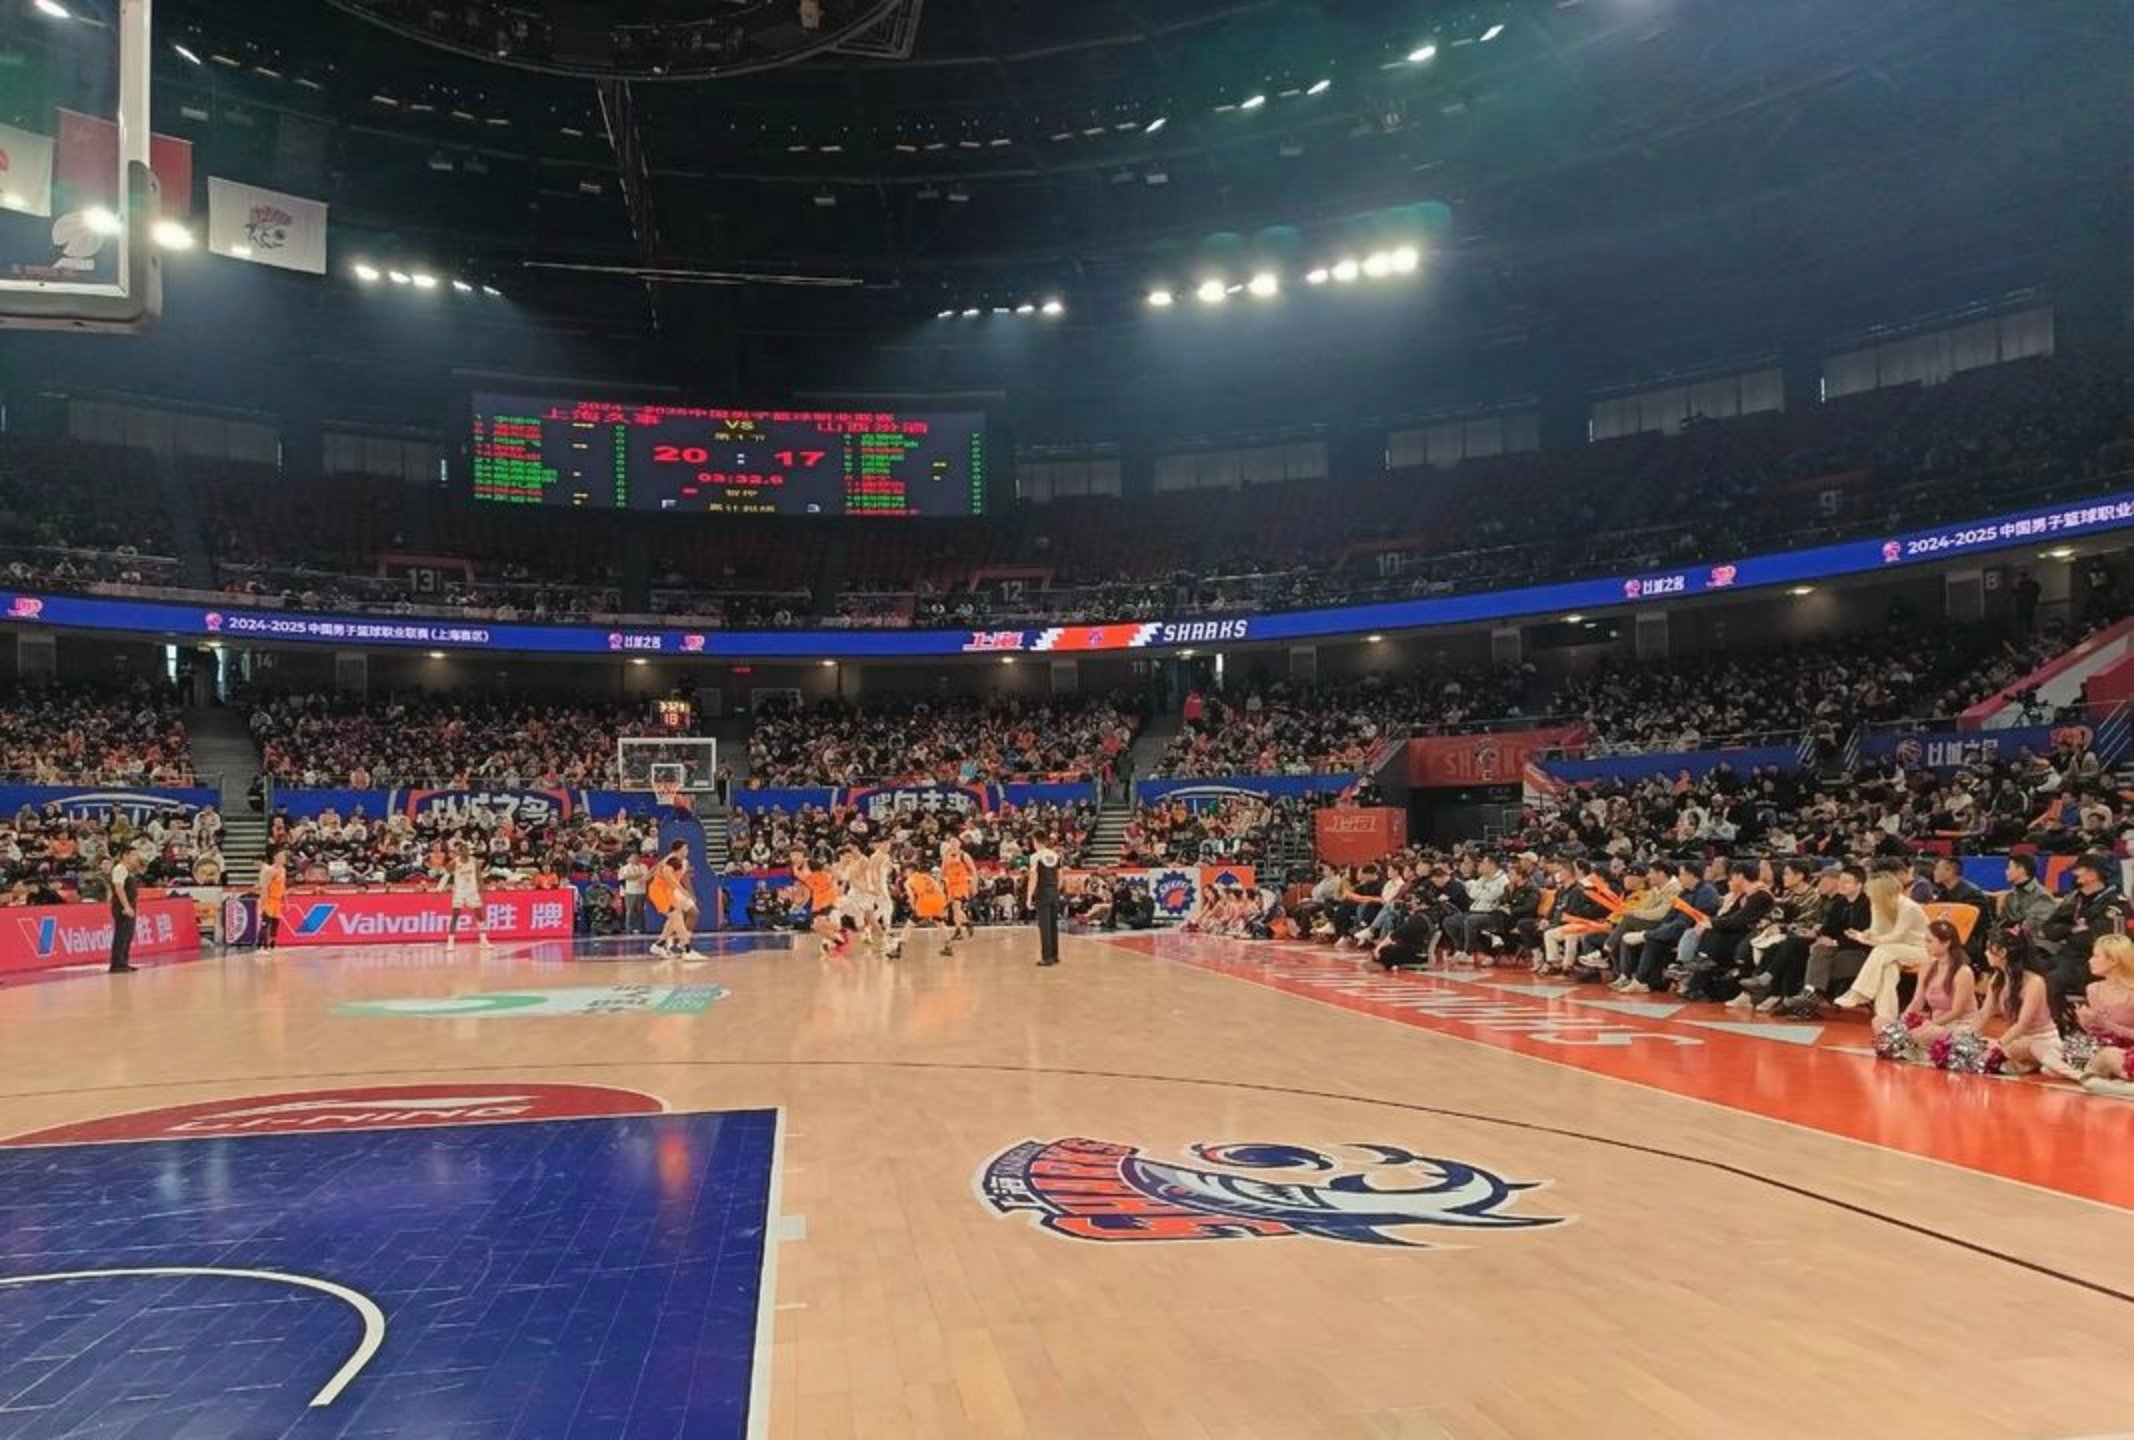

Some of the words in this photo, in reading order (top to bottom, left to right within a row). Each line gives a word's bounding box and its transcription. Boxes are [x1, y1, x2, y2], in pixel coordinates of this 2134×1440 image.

[725, 419, 755, 430] VS
[653, 446, 708, 463] 20
[773, 451, 826, 467] 17
[1907, 527, 1998, 555] 2024-2025
[1998, 499, 2134, 539] 中国男子篮球职业
[228, 617, 306, 633] 2024-2025
[1163, 619, 1250, 642] SHARKS
[338, 909, 473, 936] Valvoline
[485, 903, 564, 930] 胜牌
[165, 1106, 533, 1132] LI-NING
